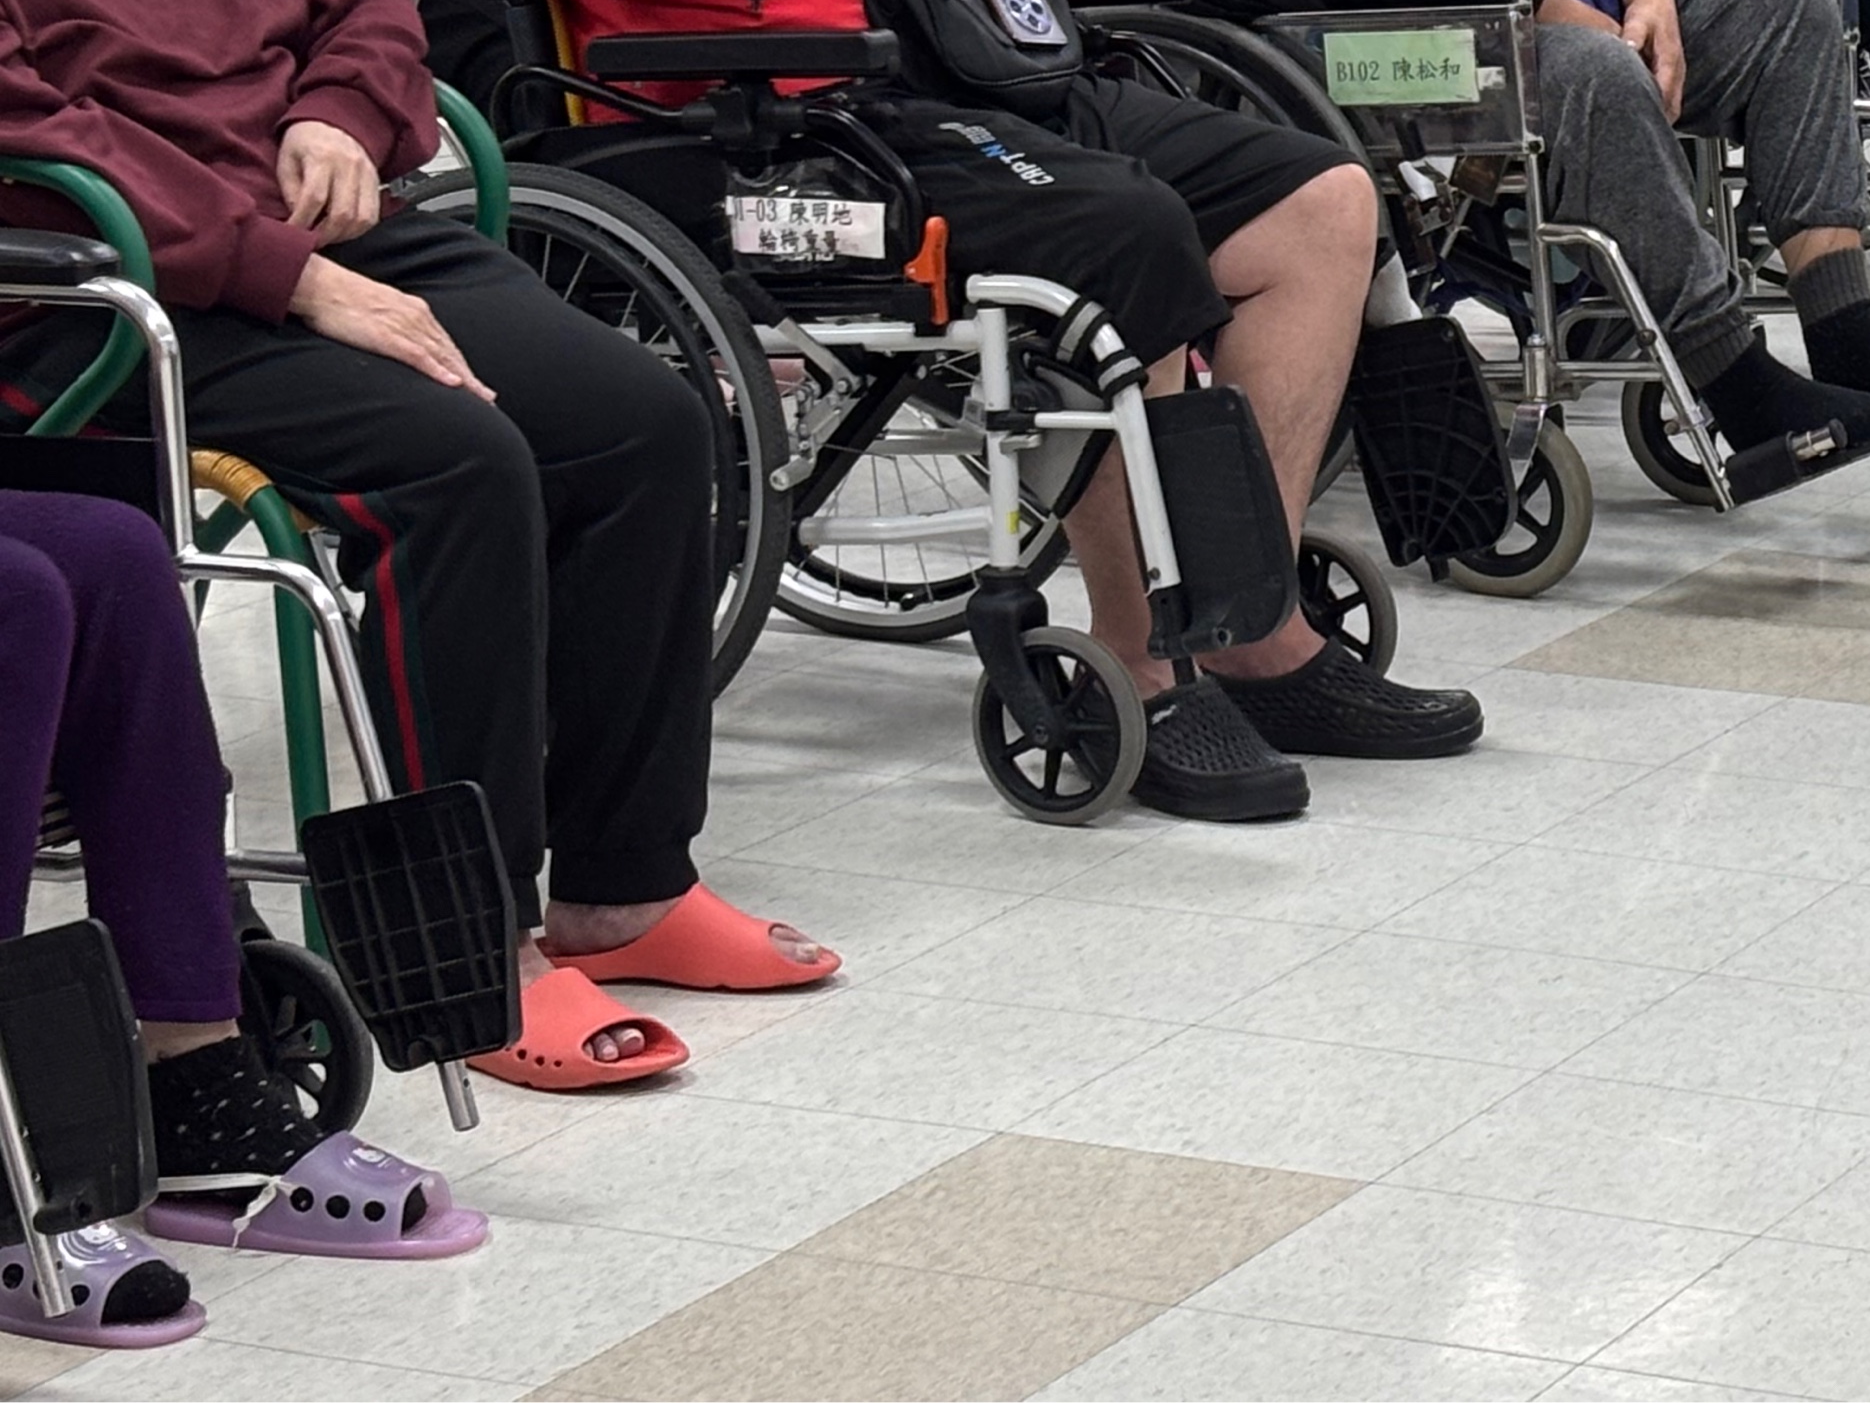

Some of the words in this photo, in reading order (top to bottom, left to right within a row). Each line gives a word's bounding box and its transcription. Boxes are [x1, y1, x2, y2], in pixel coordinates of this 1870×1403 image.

[1336, 61, 1380, 82] B102
[1392, 57, 1461, 81] 陳松和
